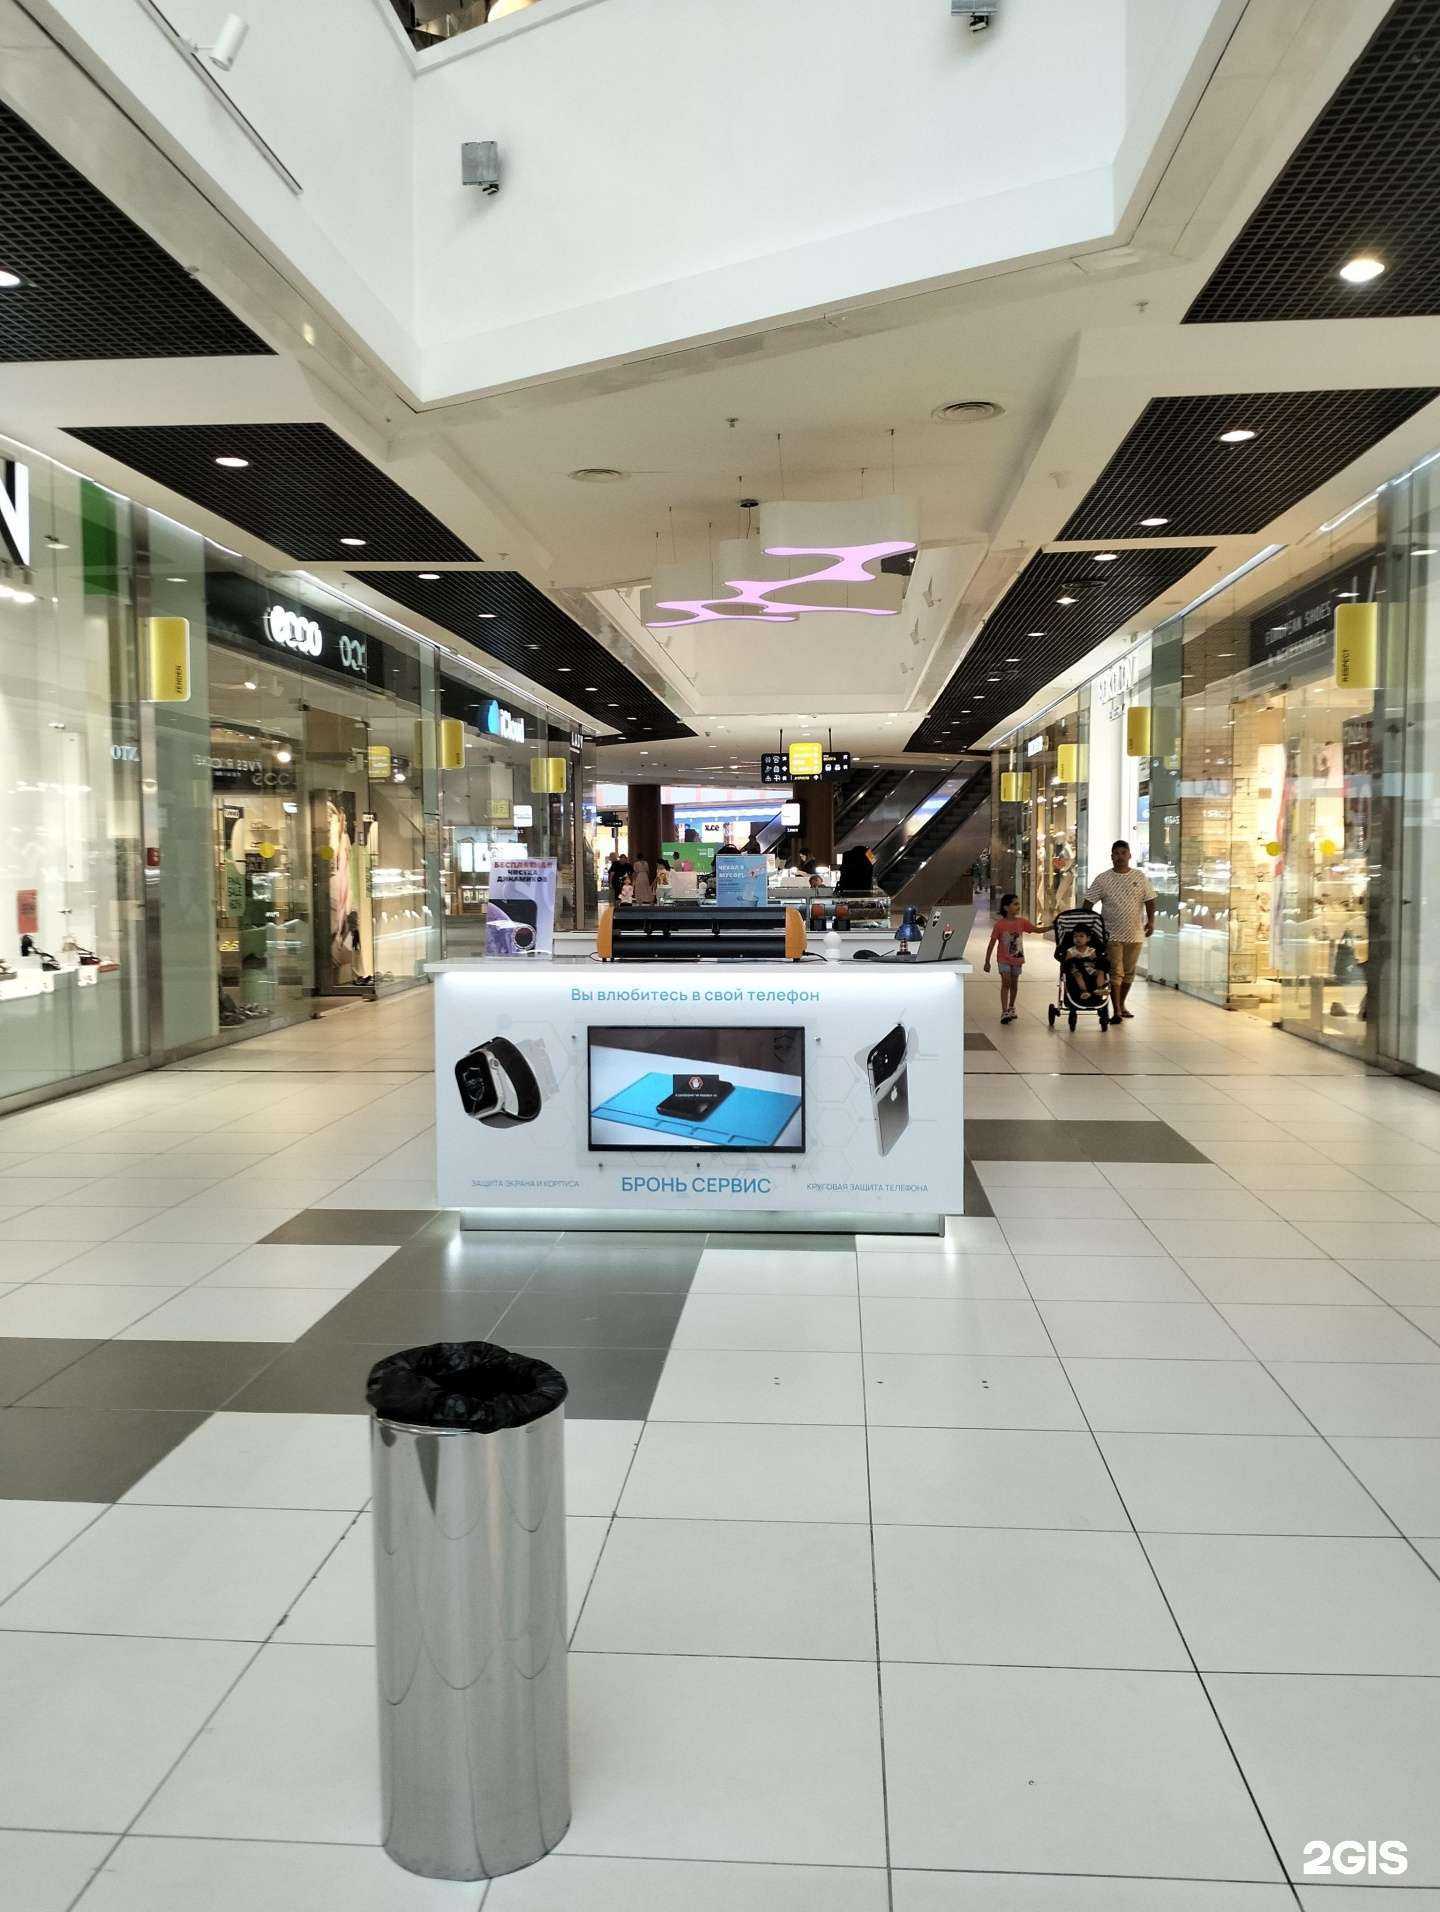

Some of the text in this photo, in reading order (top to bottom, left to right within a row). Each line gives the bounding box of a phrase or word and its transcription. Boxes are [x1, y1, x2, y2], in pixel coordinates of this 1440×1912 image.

[571, 987, 819, 1004] Вы влюбитесь в свой телефон
[622, 1176, 771, 1194] БРОНЬ СЕРВИС
[806, 1182, 929, 1193] КРУГОВАЯ ЗАЩИТА ТЕЛЕФОНА
